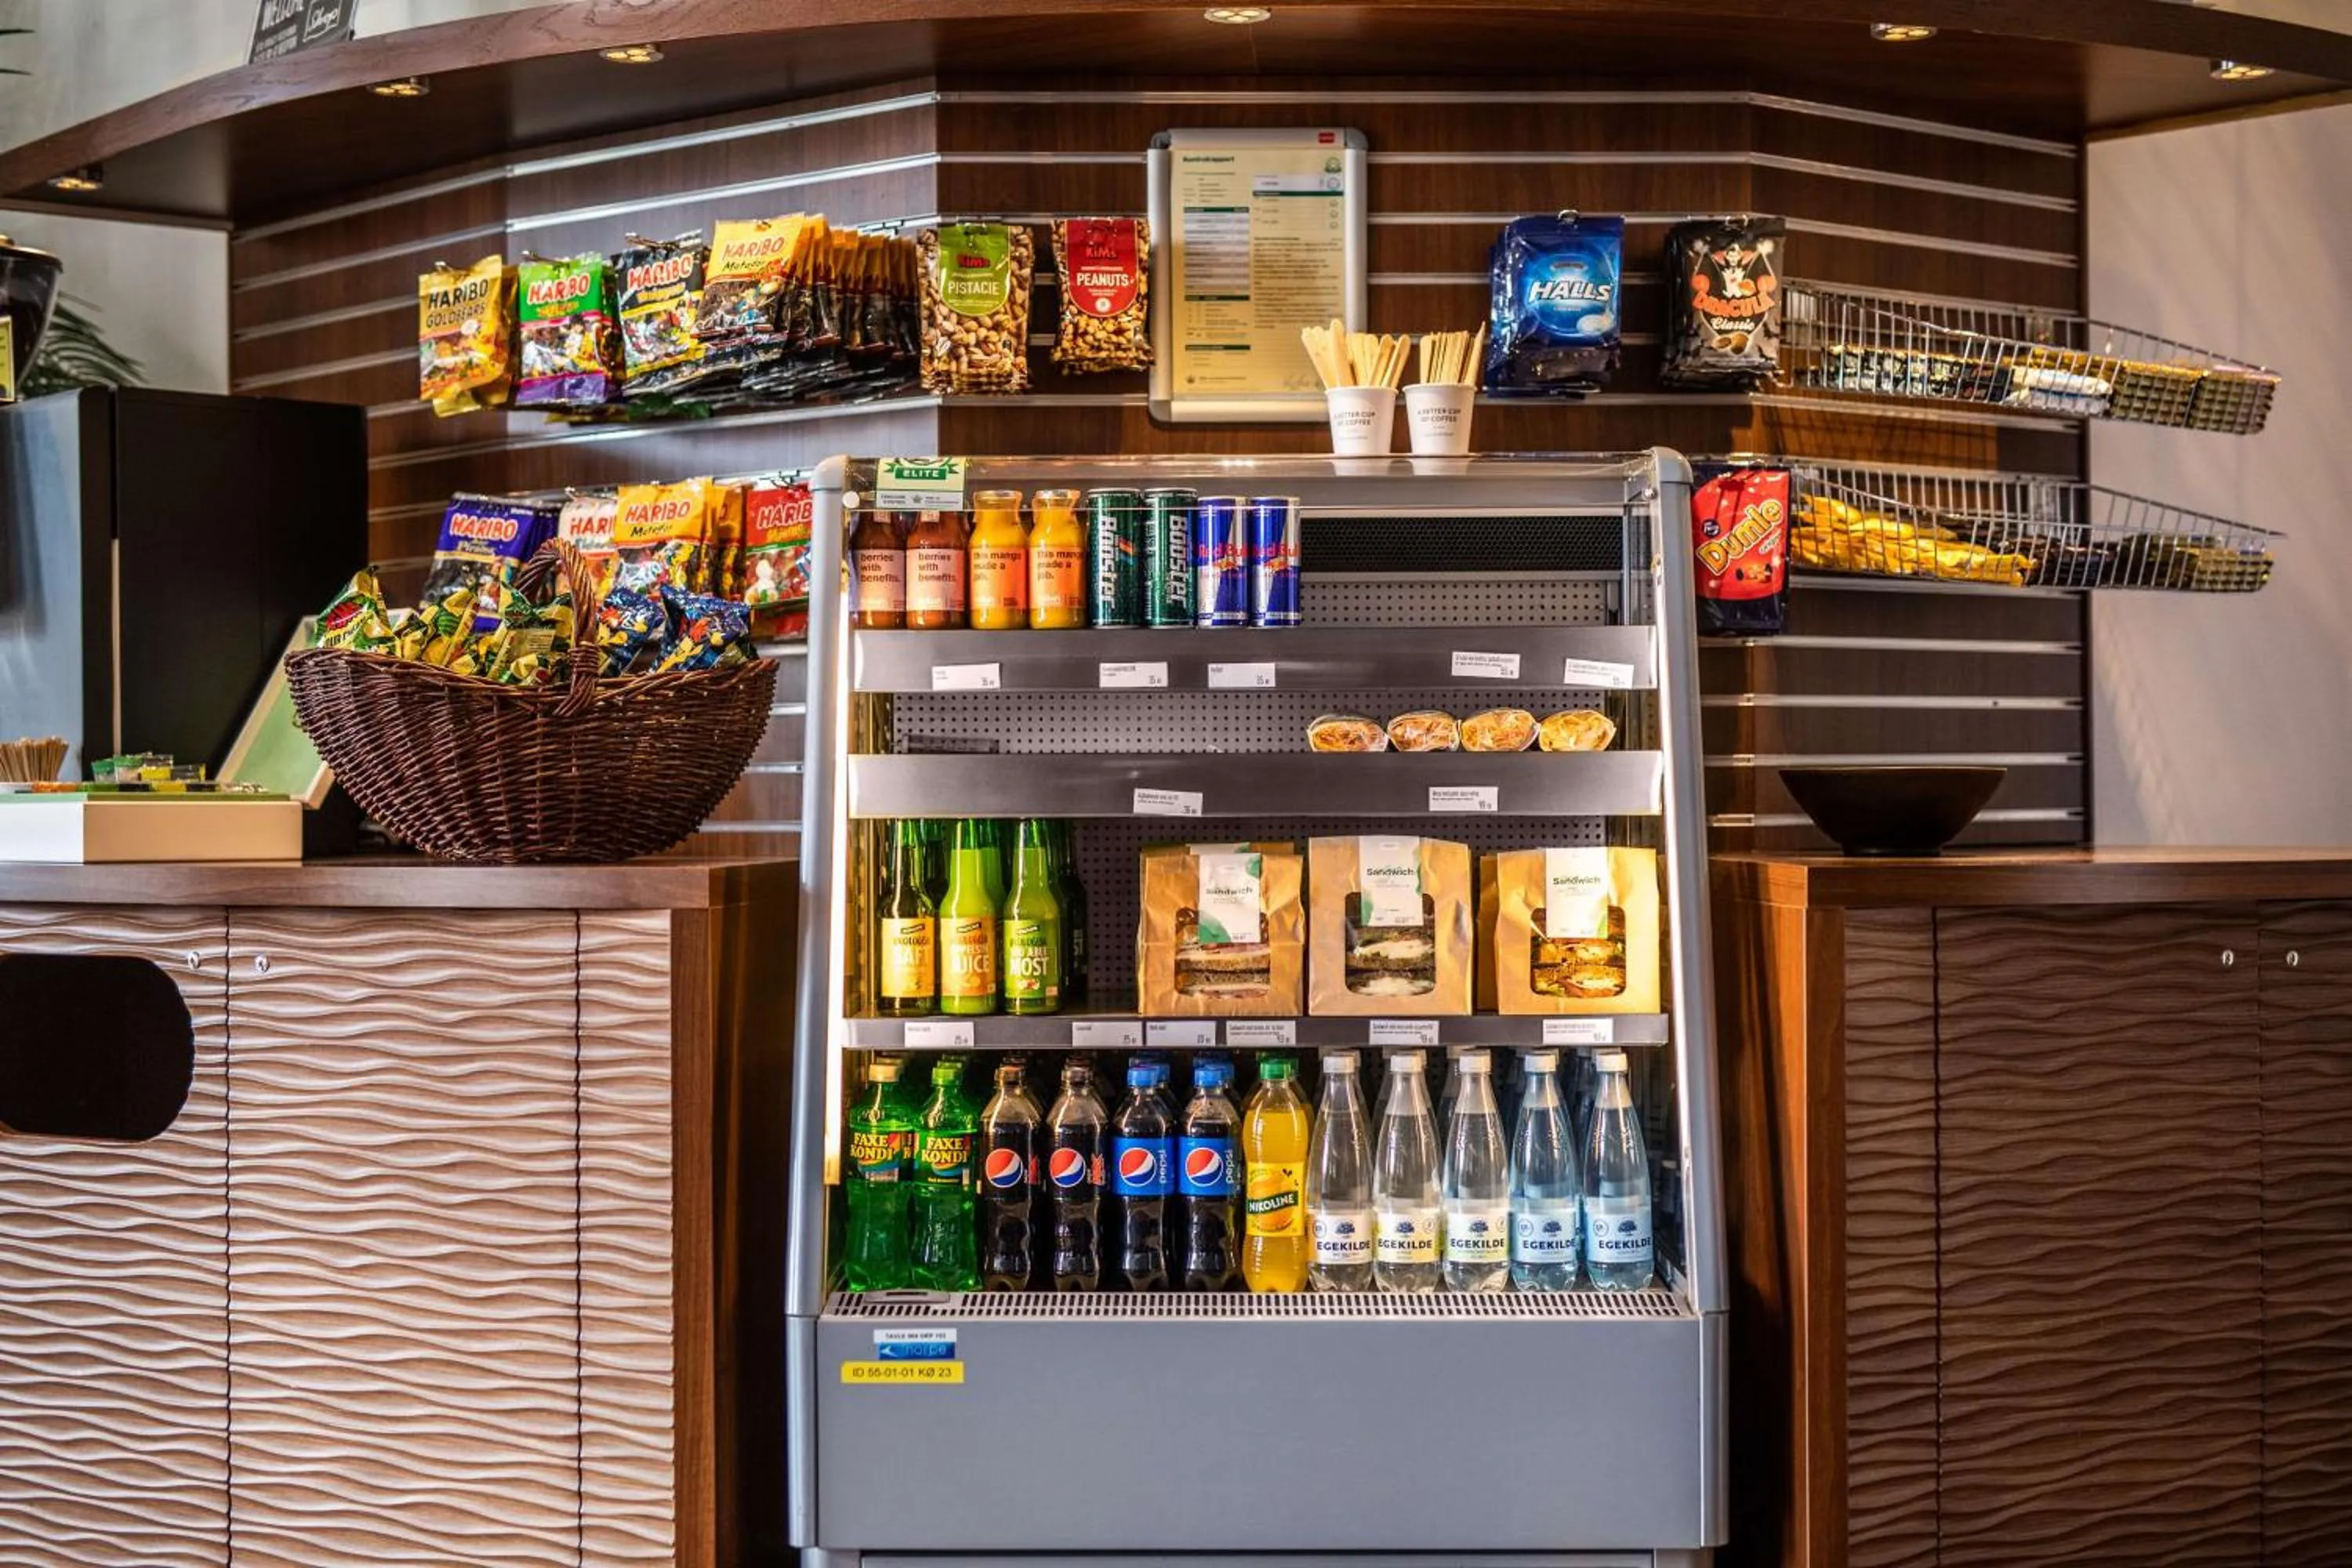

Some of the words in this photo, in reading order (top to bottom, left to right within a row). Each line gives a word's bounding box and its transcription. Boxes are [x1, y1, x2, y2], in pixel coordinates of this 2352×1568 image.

[724, 237, 785, 259] HARIBO
[628, 254, 693, 290] HARIBO
[1076, 272, 1129, 288] PEANUTS
[428, 278, 488, 308] HARIBO
[528, 274, 590, 304] HARIBO
[947, 280, 1000, 296] PISTACIE
[1528, 279, 1612, 303] HALLS
[625, 501, 691, 523] HARIBO
[757, 499, 812, 530] HARIB
[449, 512, 518, 542] HARIBO
[570, 515, 617, 535] HARI
[1696, 499, 1784, 577] Dumle
[860, 553, 894, 562] berries
[919, 551, 951, 561] berries
[919, 563, 938, 572] with
[1367, 867, 1415, 877] Sandwich
[1552, 876, 1601, 885] Sandwich
[853, 1132, 888, 1147] FAXE
[926, 1137, 964, 1150] FAXE
[850, 1145, 893, 1160] KONDI
[921, 1149, 967, 1163] KONDI
[1158, 1149, 1167, 1184] pepsi
[1225, 1149, 1235, 1184] pepsi
[1248, 1193, 1295, 1213] NIKOLINE
[1316, 1240, 1370, 1251] EGEKILDE
[1377, 1238, 1433, 1250] EGEKILDE
[1450, 1238, 1504, 1249] EGEKILDE
[1523, 1238, 1577, 1250] EGEKILDE
[1598, 1237, 1653, 1249] EGEKILDE
[852, 1367, 865, 1377] ID
[917, 1367, 935, 1377] KØ
[938, 1367, 952, 1377] 23
